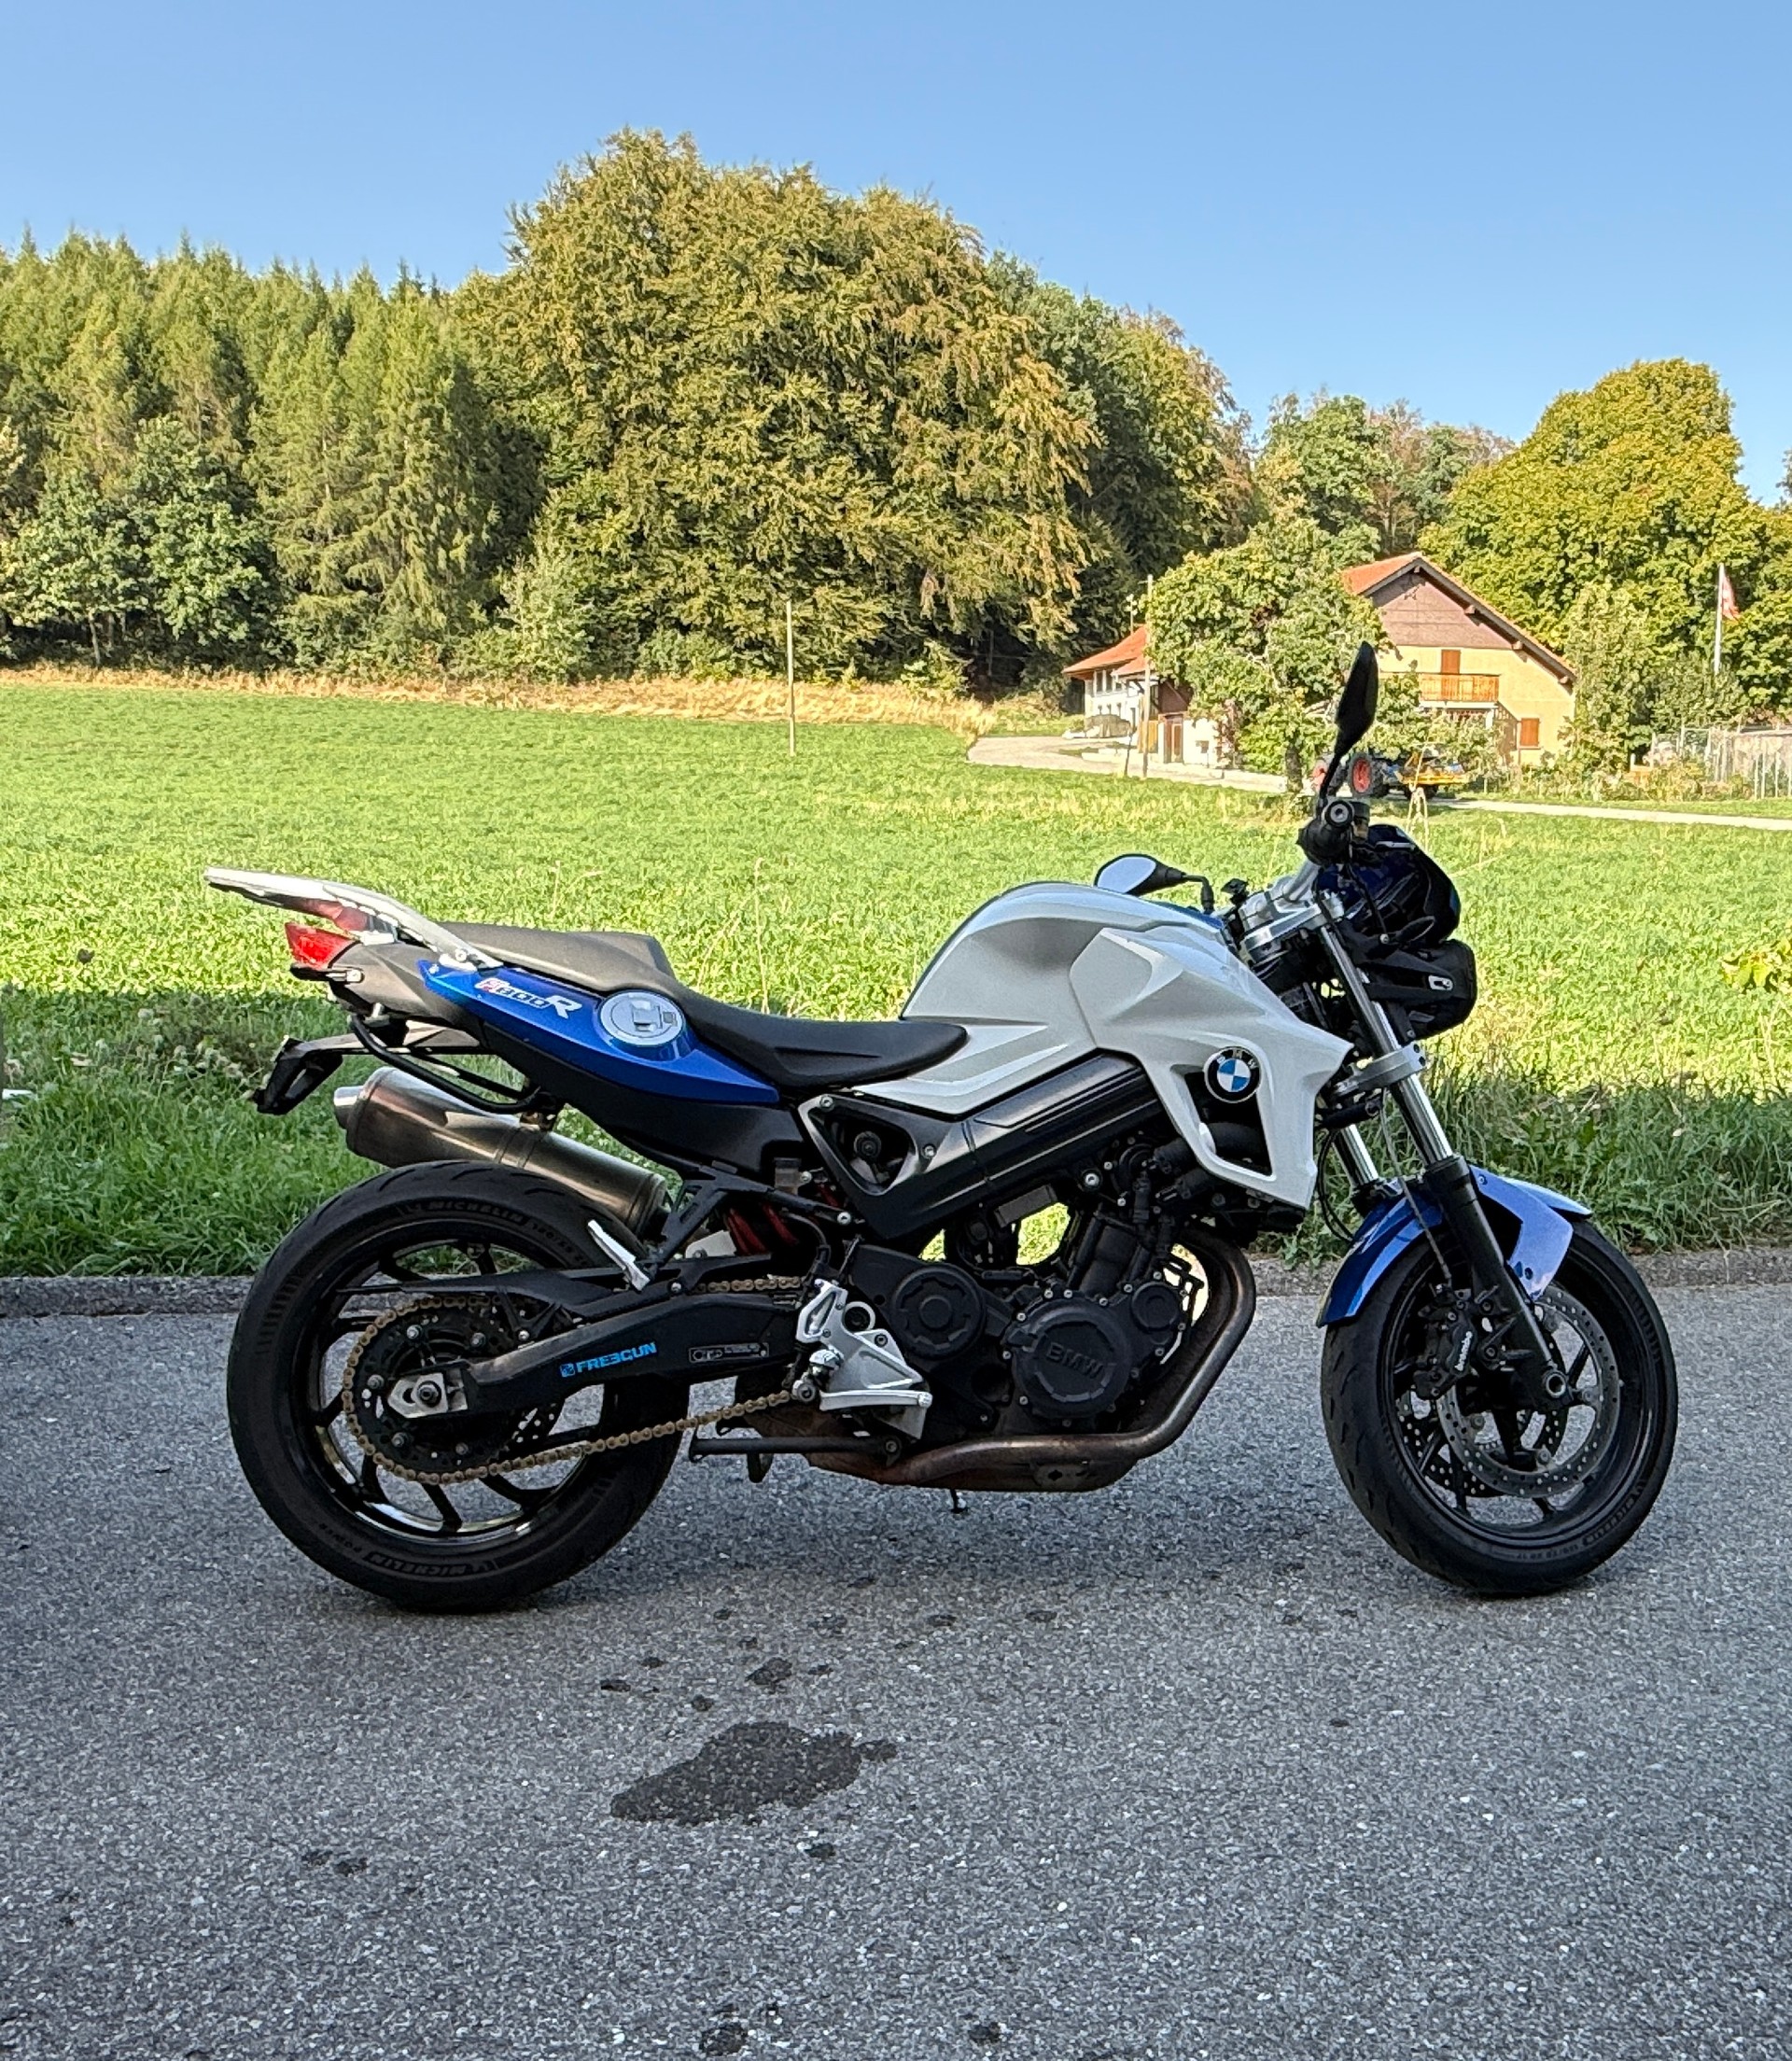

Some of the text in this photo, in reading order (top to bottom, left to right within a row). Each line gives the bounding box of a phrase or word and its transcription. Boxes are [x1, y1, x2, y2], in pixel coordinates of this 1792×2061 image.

[1216, 1049, 1258, 1069] BMW
[428, 1200, 525, 1225] MICHELIN
[576, 1341, 657, 1373] FREEGUN
[1046, 1342, 1104, 1379] BMW
[367, 1552, 467, 1577] MICHELIN
